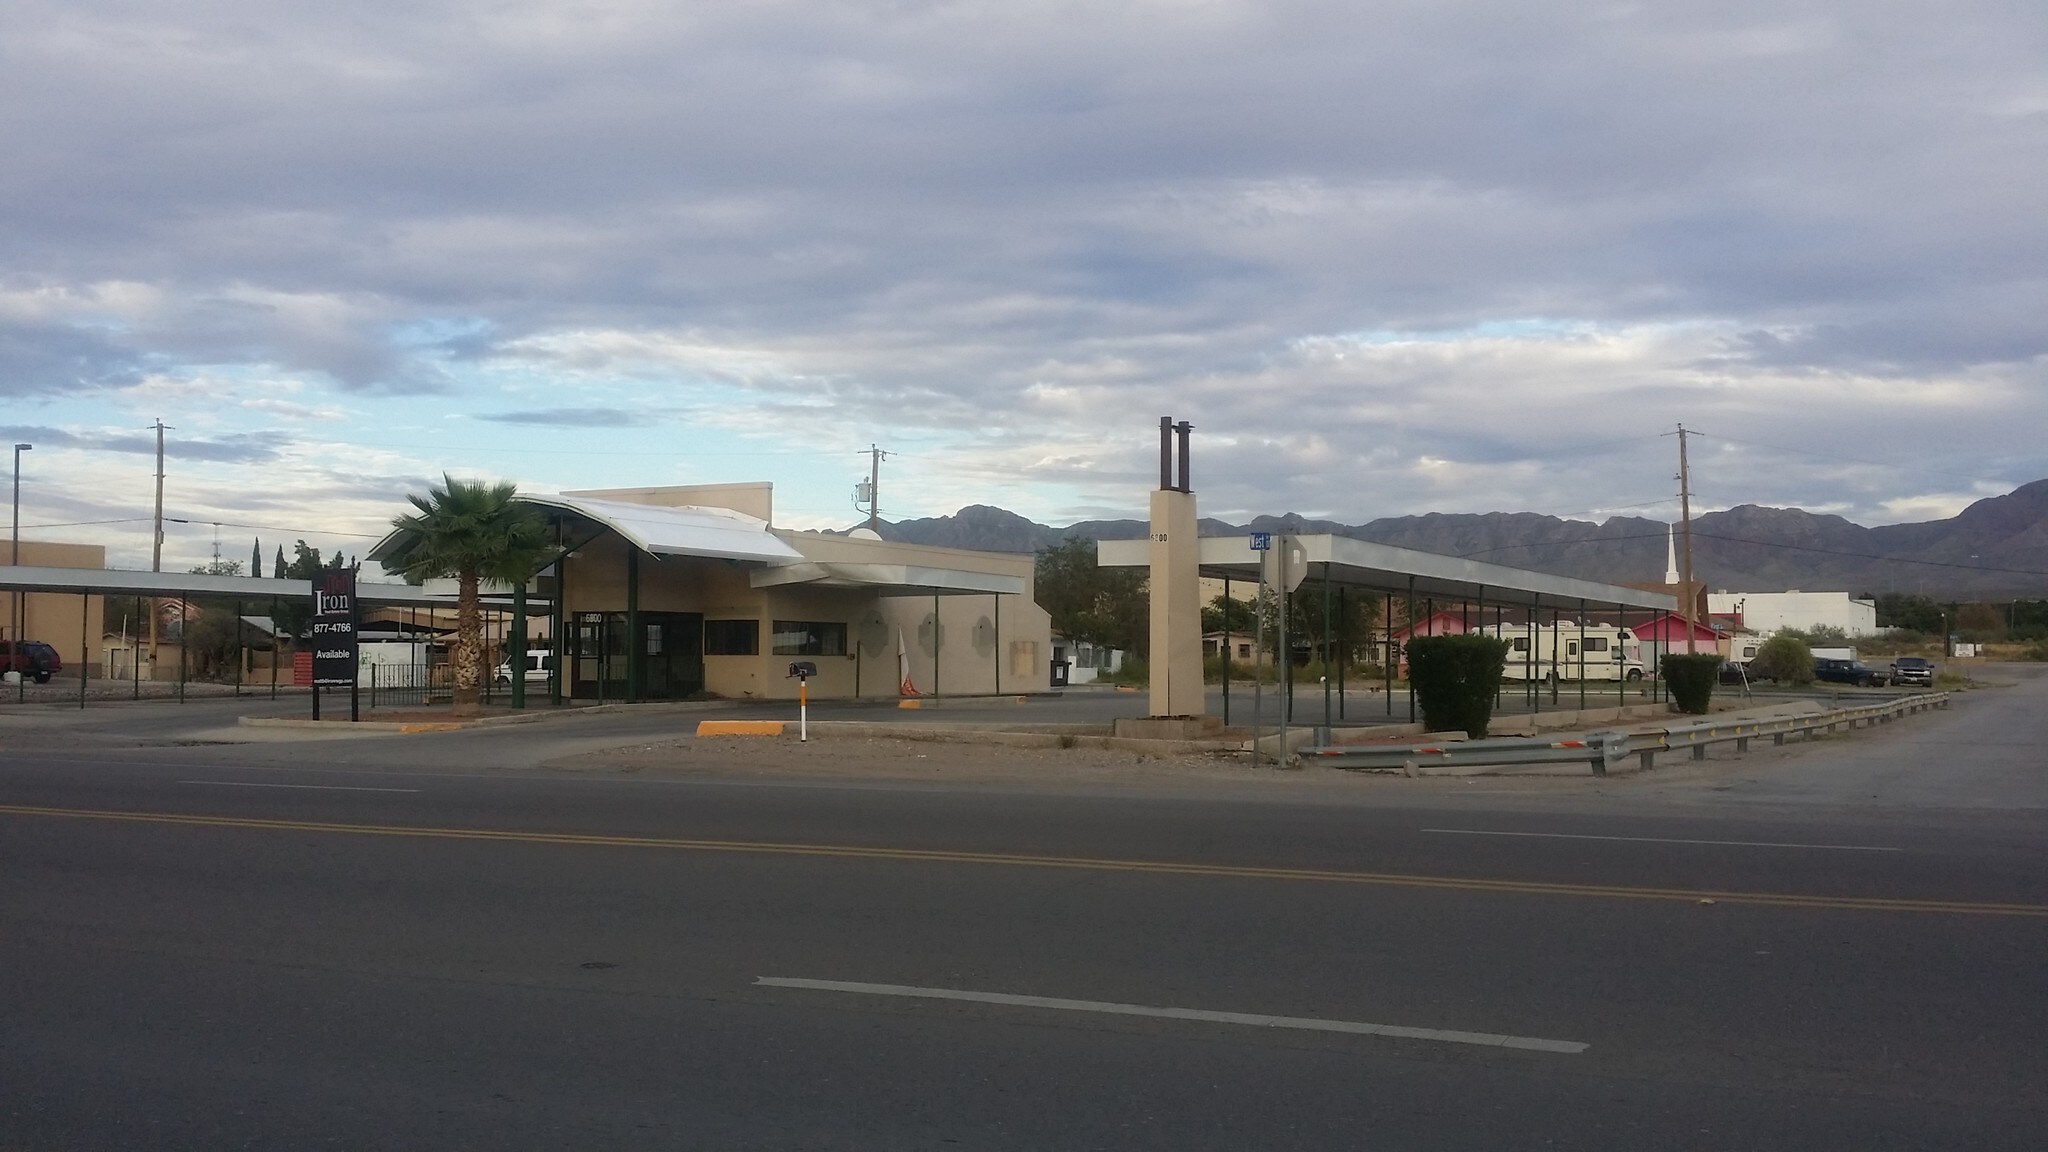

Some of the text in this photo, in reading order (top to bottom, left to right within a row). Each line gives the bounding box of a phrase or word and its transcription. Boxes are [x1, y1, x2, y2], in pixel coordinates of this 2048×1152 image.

[1250, 534, 1264, 548] West
[314, 590, 348, 616] Iron
[586, 613, 602, 623] 6800
[314, 622, 351, 633] 877-4766
[316, 649, 350, 659] Available
